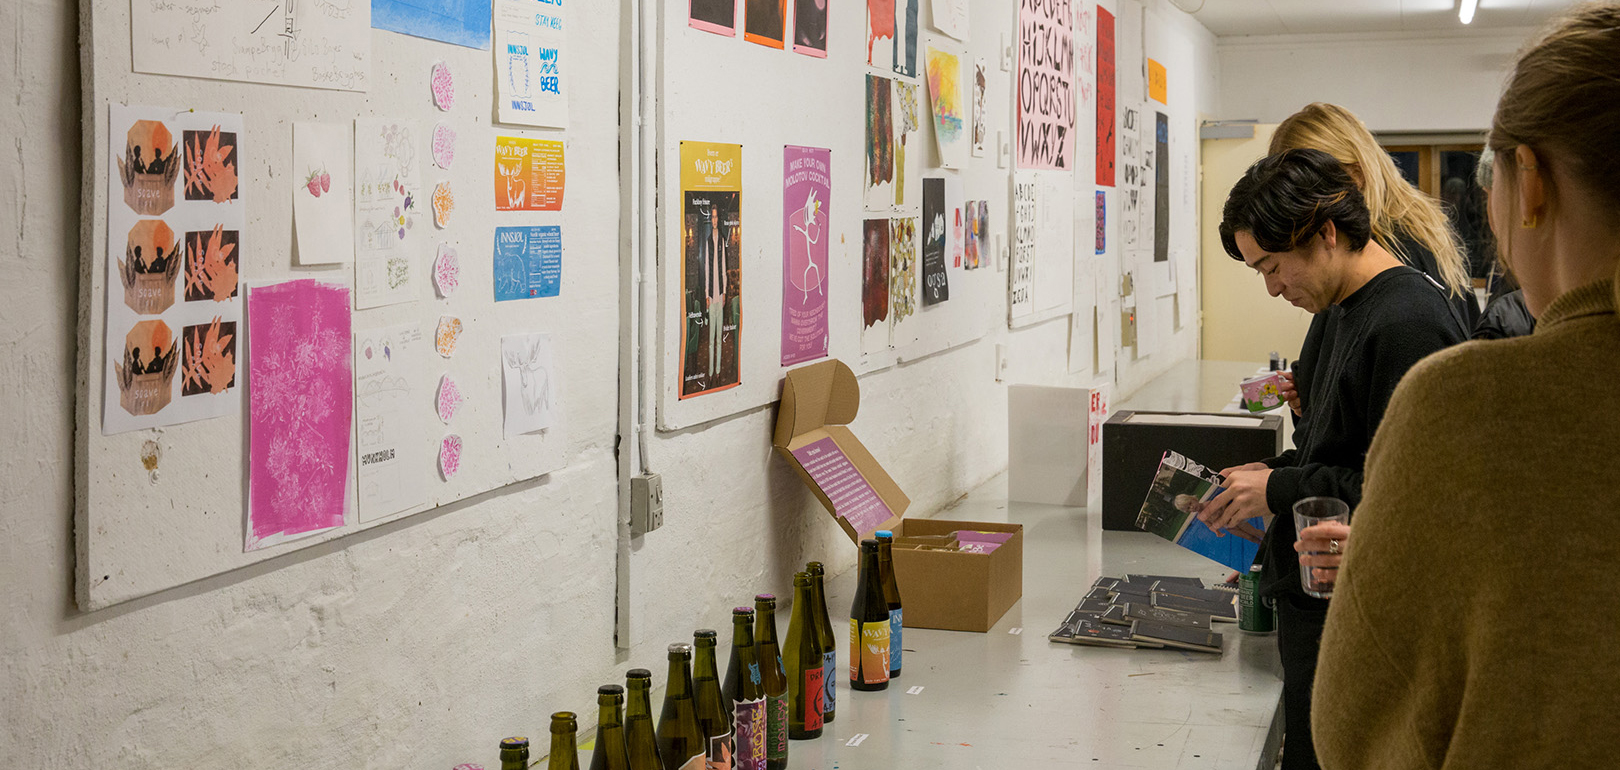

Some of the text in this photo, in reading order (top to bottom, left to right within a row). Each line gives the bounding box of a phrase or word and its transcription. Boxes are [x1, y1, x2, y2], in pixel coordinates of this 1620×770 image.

[539, 47, 558, 63] WAVY
[540, 76, 560, 95] BEER
[496, 144, 528, 157] WAVY BEER
[695, 158, 714, 174] WAVY
[790, 157, 826, 173] MAKE YOUR OWN
[785, 171, 808, 188] MOLOTOV
[863, 628, 889, 639] WAVY
[777, 699, 787, 752] MOLDY
